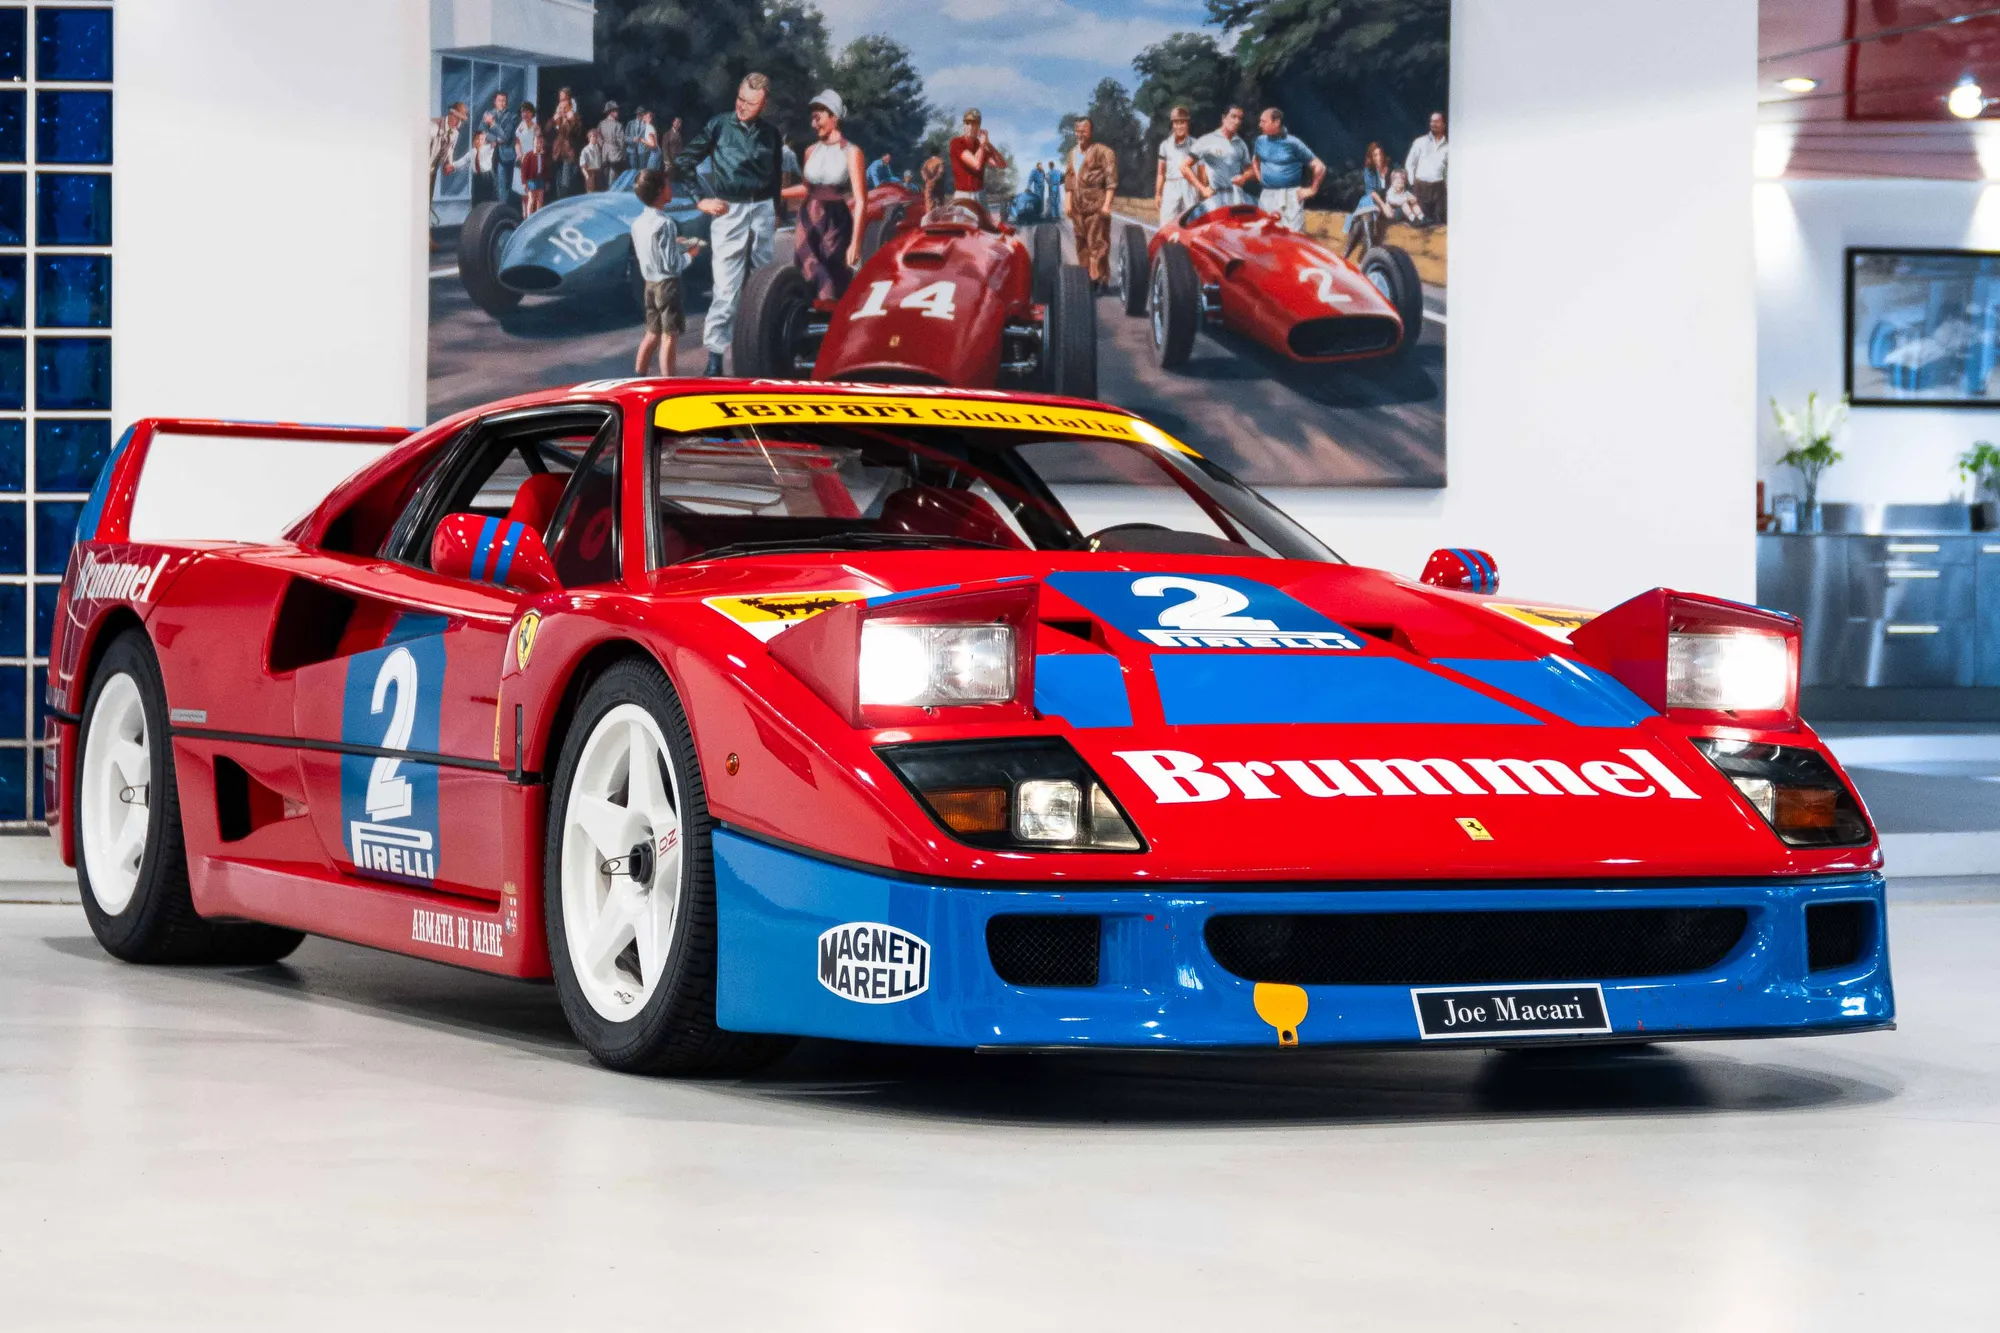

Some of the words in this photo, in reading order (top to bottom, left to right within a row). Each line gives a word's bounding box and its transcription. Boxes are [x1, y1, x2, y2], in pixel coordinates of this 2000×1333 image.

[549, 227, 597, 260] 18
[849, 280, 956, 320] 14
[1300, 268, 1352, 303] 2
[712, 400, 924, 419] Ferrari
[931, 408, 1021, 424] Club
[1024, 413, 1130, 435] Italia
[1131, 576, 1280, 631] 2
[1138, 629, 1361, 650] PIRELLI
[365, 647, 418, 822] 2
[1111, 748, 1702, 804] Brummel
[350, 820, 435, 880] PIRELLI
[659, 828, 677, 852] OZ
[412, 909, 455, 947] ARMATA
[458, 916, 469, 951] DI
[473, 920, 503, 957] MARE
[821, 927, 926, 972] MAGNETI
[821, 960, 926, 999] MARELLI
[1444, 999, 1487, 1026] Joe
[1492, 996, 1584, 1022] Macari
